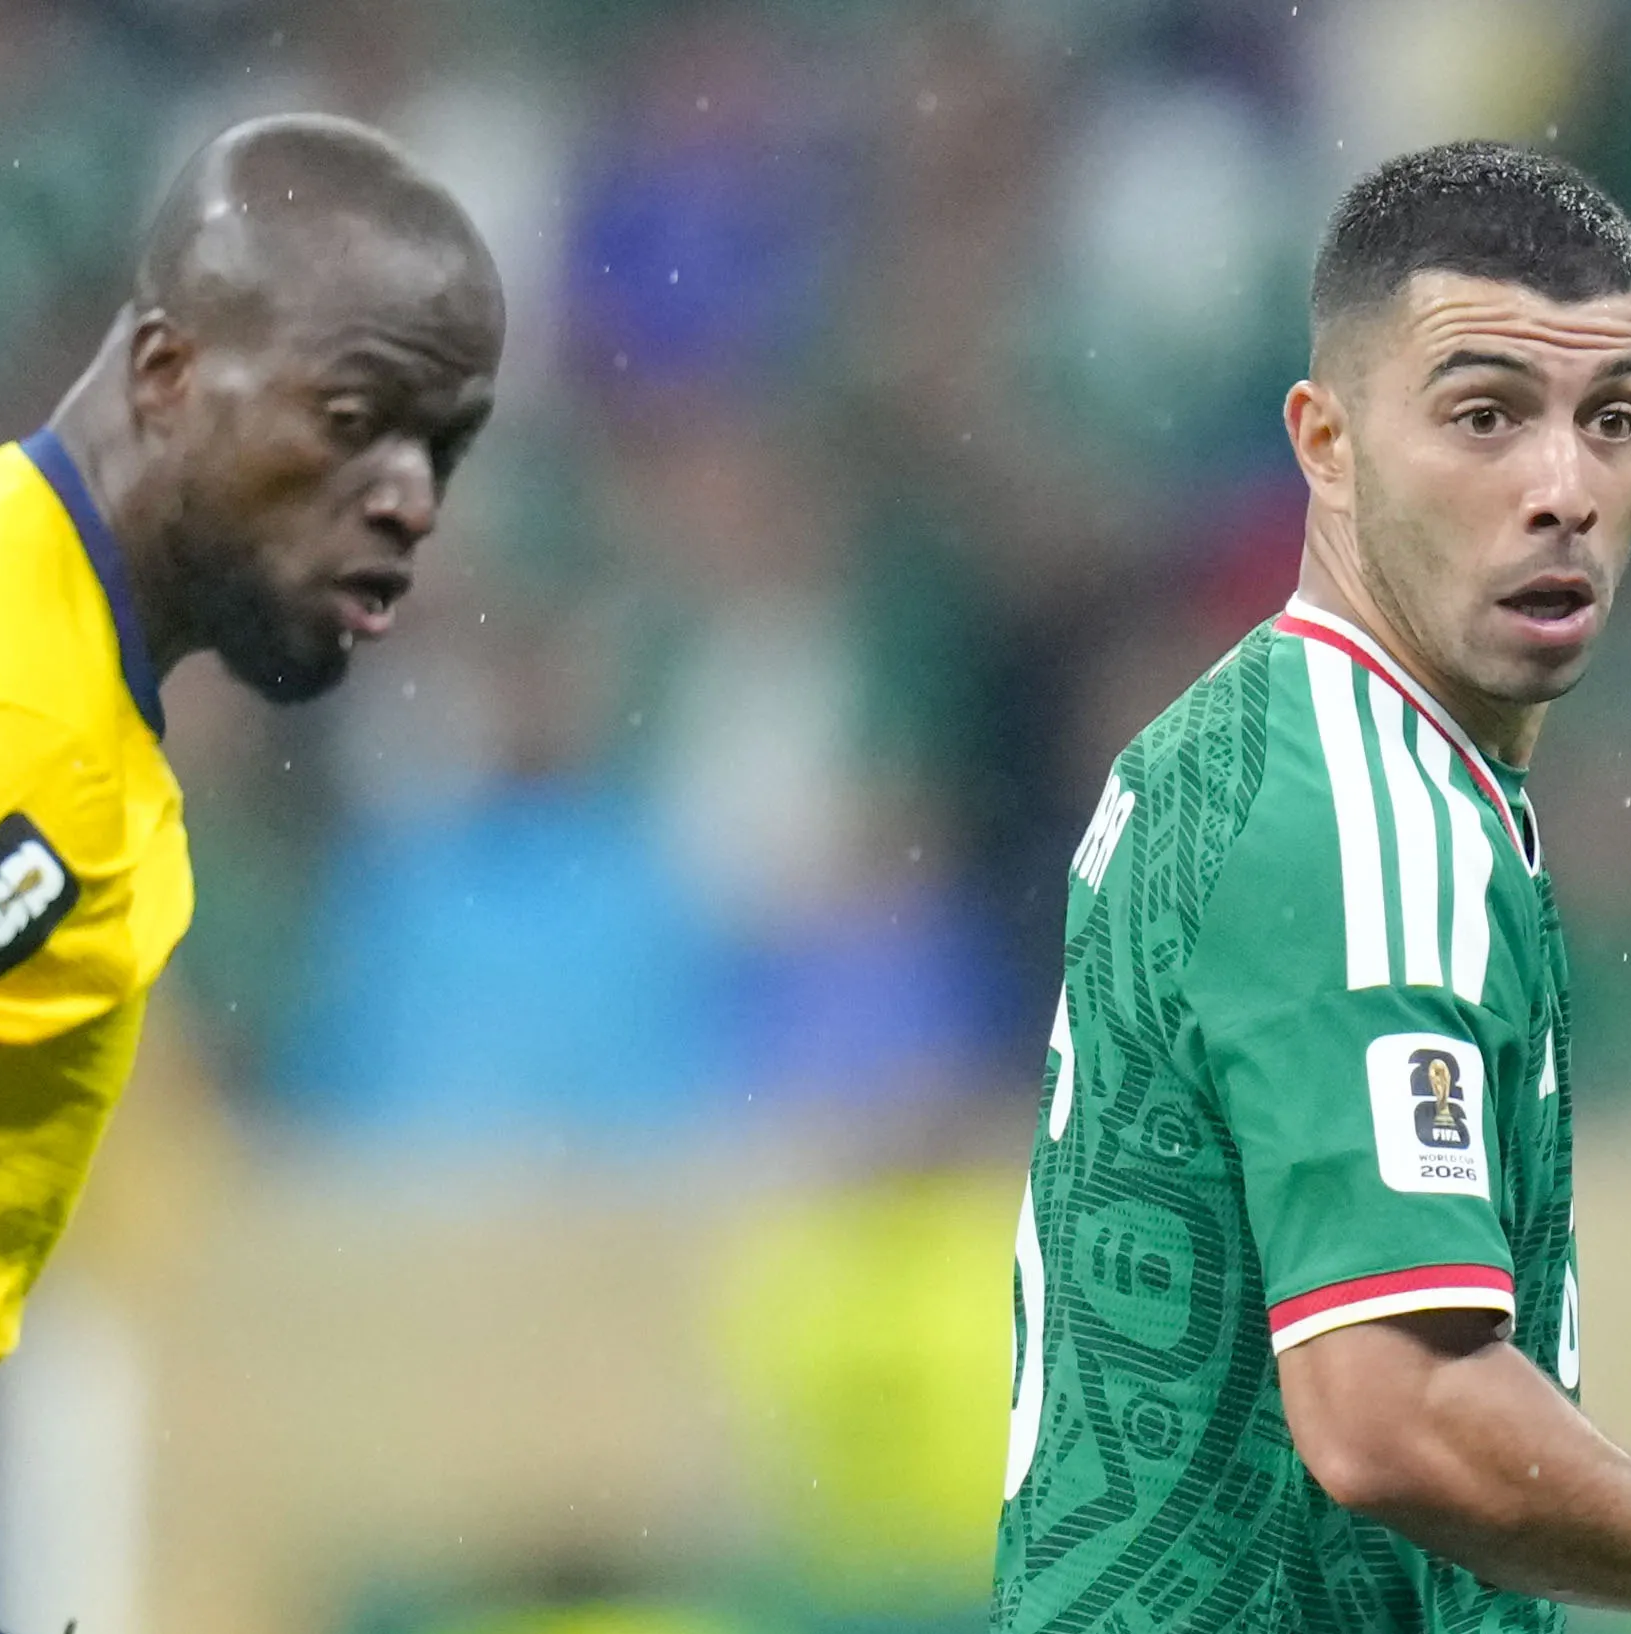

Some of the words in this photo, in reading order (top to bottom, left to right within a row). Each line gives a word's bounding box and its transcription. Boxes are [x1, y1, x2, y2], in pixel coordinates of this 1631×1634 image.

[1431, 1127, 1463, 1143] FIFA
[1419, 1153, 1457, 1163] WORLD
[1420, 1164, 1478, 1182] 2026
